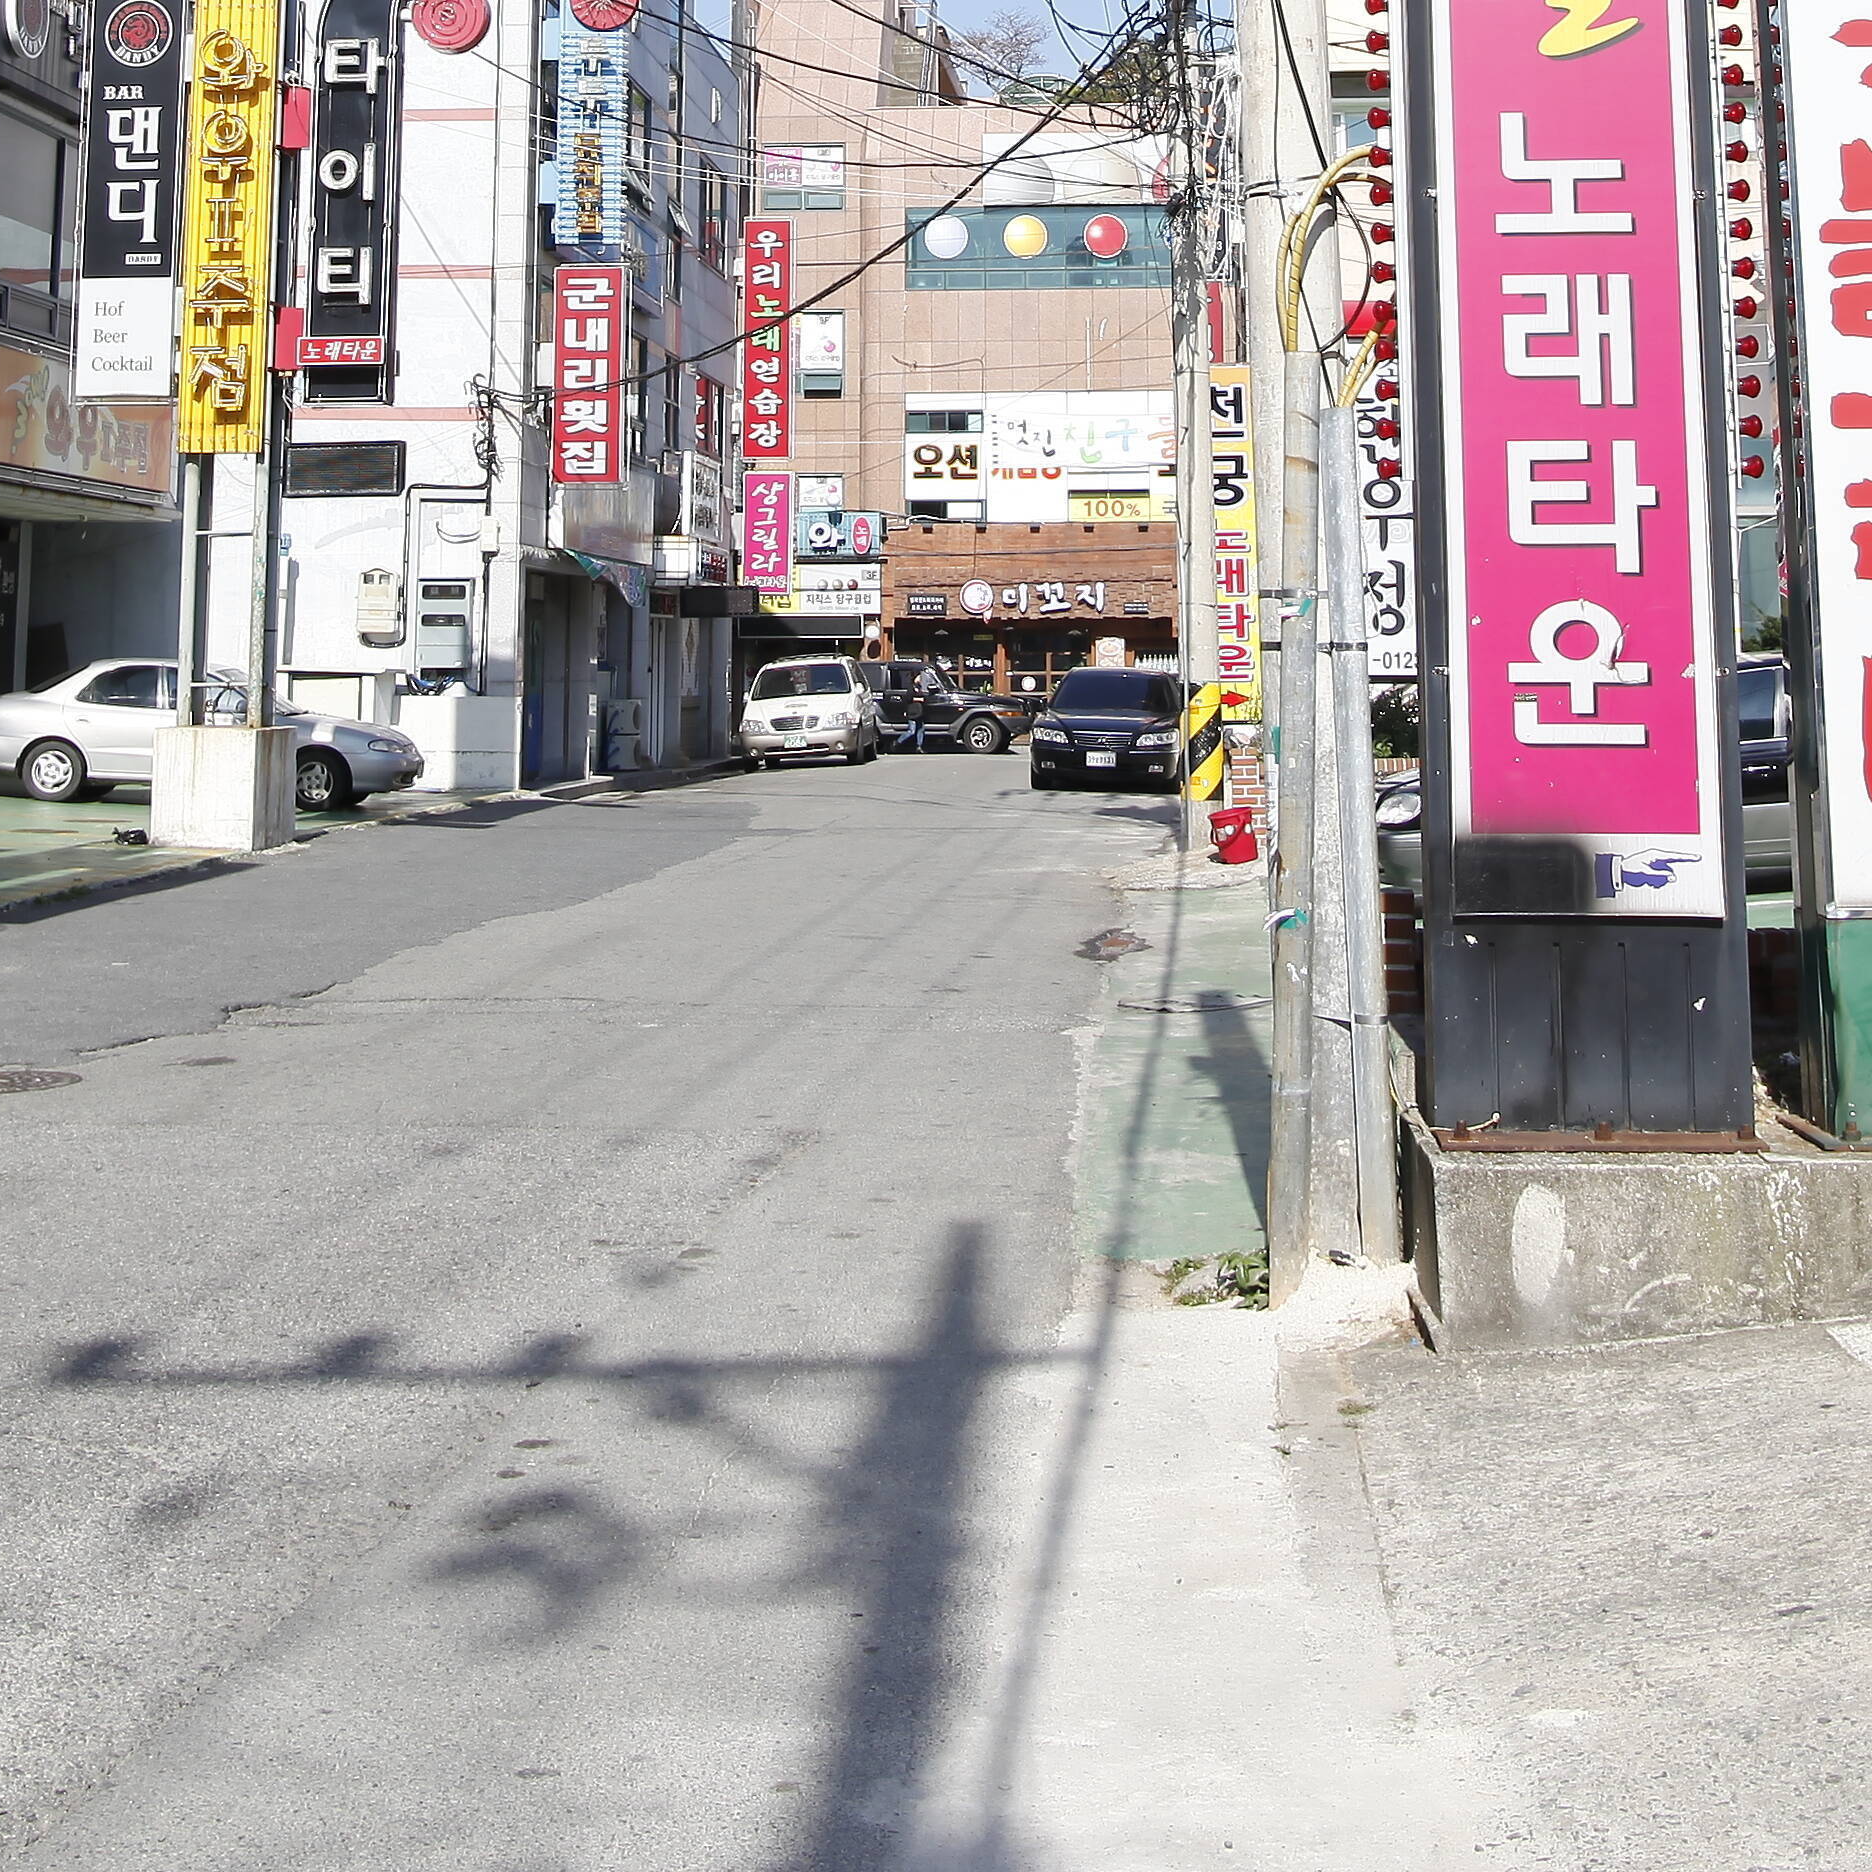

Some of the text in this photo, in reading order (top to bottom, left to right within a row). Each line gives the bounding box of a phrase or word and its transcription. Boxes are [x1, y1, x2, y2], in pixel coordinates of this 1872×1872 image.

[102, 84, 145, 101] BAR
[105, 104, 165, 245] 댄디
[94, 299, 126, 318] Hof
[92, 328, 128, 344] Beer
[747, 228, 787, 449] 우리 노래연습장
[91, 355, 153, 373] Cocktail
[301, 339, 379, 363] 노래타운
[558, 275, 616, 477] 군내리횟집
[1494, 111, 1659, 748] 노래타운
[913, 444, 979, 480] 오션
[1083, 500, 1142, 518] 100%
[808, 521, 847, 549] 와
